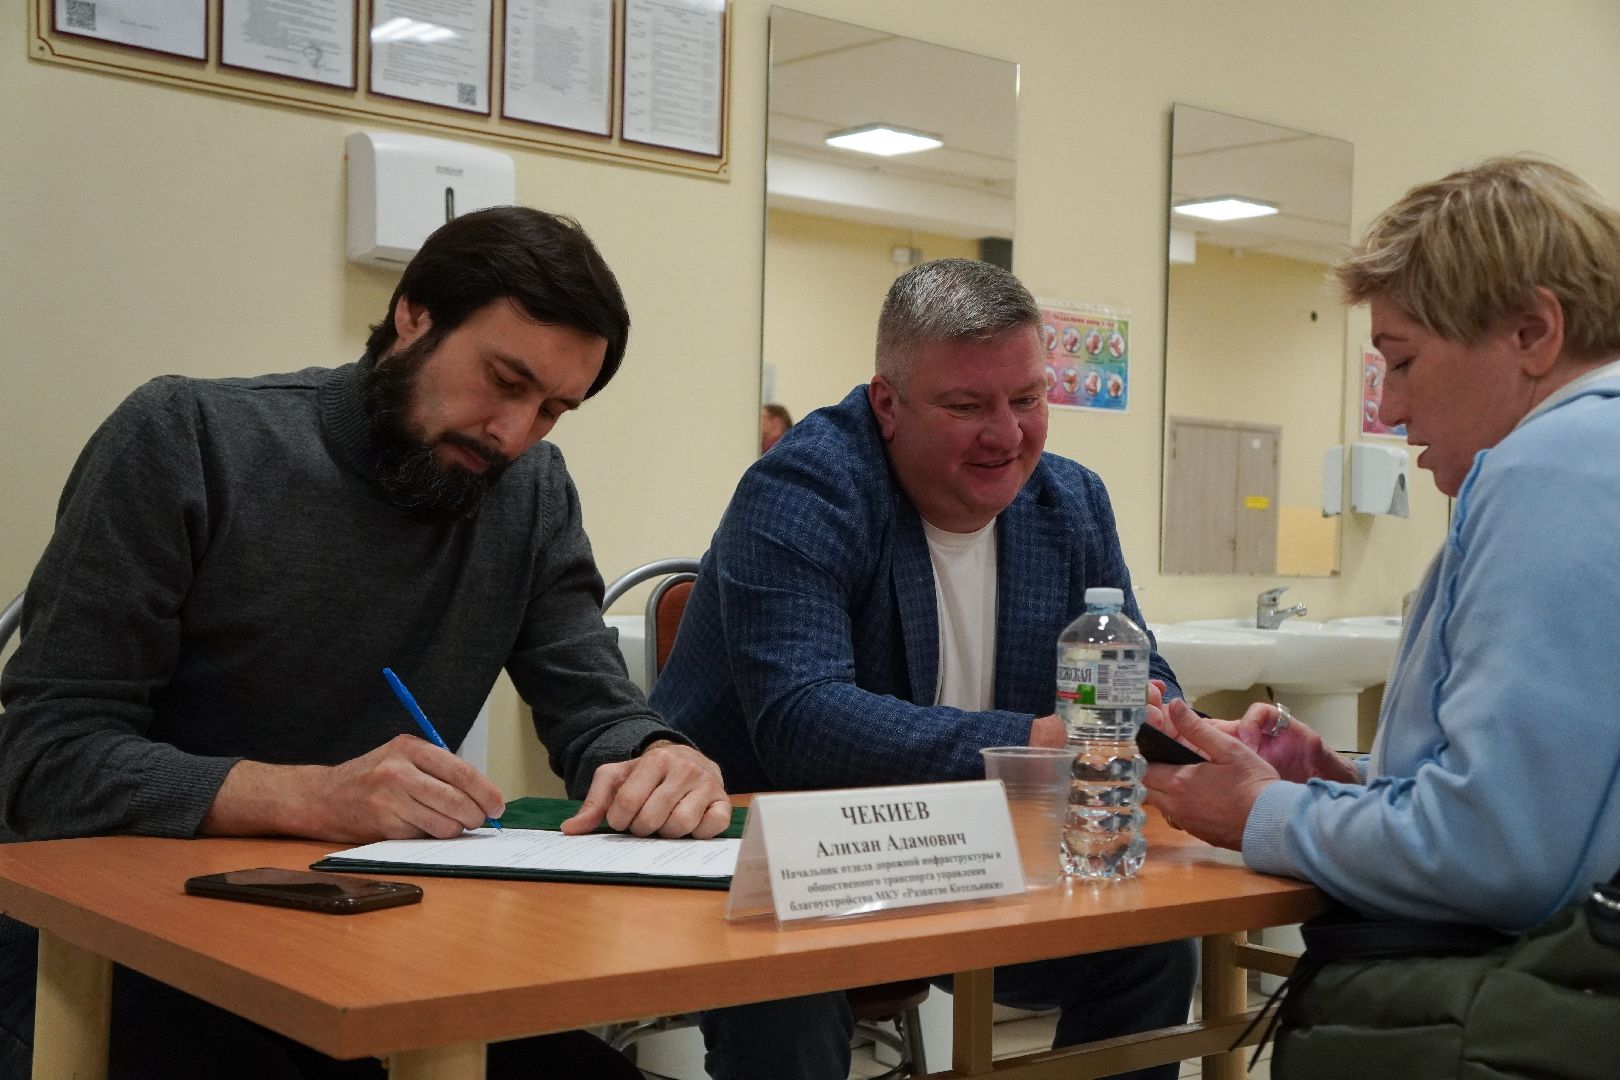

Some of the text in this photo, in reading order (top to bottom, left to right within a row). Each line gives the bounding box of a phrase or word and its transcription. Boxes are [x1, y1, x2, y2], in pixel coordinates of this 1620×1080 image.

[840, 801, 930, 825] ЧЕКИЕВ
[816, 832, 967, 858] Алихан Адамович
[781, 851, 1002, 880] Начальник отдела дорожной инфраструктуры и
[807, 868, 987, 893] общественного транспорта управления
[789, 894, 874, 912] благоустройства
[875, 889, 898, 901] МКУ
